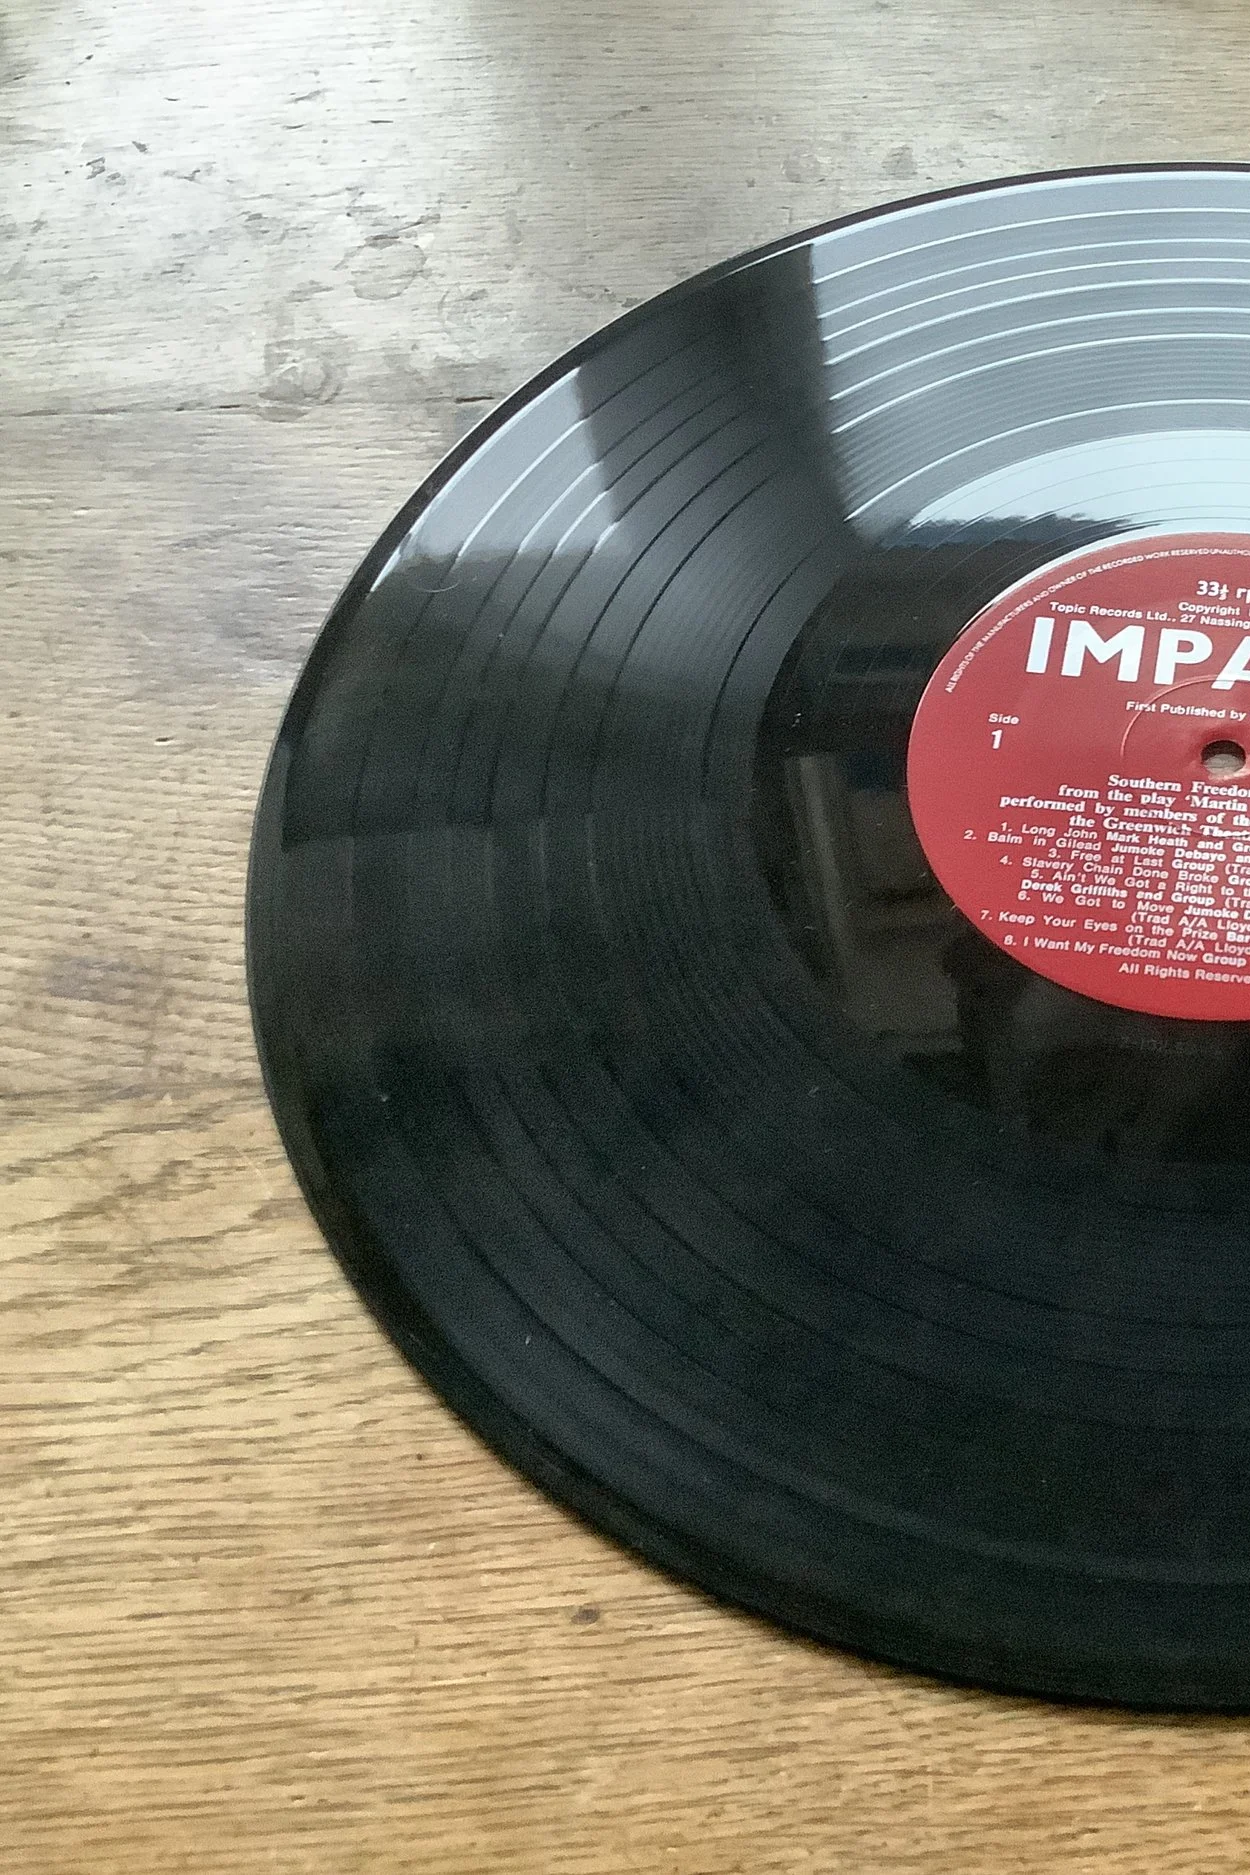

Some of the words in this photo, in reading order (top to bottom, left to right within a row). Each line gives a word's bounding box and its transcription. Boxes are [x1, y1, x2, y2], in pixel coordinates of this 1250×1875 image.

[1049, 601, 1086, 614] Topic
[1089, 605, 1143, 619] Records
[1180, 614, 1196, 623] 27
[1178, 602, 1240, 616] Copyright
[988, 713, 1020, 725] Side
[1125, 701, 1156, 713] First
[1160, 703, 1226, 719] Published
[1230, 709, 1247, 722] by
[990, 729, 1003, 750] 1
[1107, 774, 1182, 792] Southern
[1058, 785, 1099, 799] from
[1107, 789, 1133, 802] the
[1140, 793, 1176, 807] play
[999, 795, 1086, 812] performed
[1095, 802, 1115, 816] by
[1123, 807, 1198, 823] members
[1206, 812, 1225, 825] of
[1000, 822, 1012, 832] 1.
[1021, 823, 1056, 838] Long
[1064, 827, 1098, 840] John
[1106, 831, 1140, 844] Mark
[1147, 834, 1189, 848] Heath
[1197, 839, 1224, 851] and
[1069, 815, 1095, 828] the
[1103, 817, 1192, 836] Greenwich
[963, 830, 977, 840] 2.
[987, 831, 1023, 844] Balm
[1033, 835, 1047, 847] in
[1056, 837, 1102, 851] Gilead
[1111, 842, 1165, 857] Jumoke
[1175, 847, 1227, 863] Debayo
[999, 854, 1013, 866] 4.
[1022, 856, 1074, 873] Slavery
[1083, 862, 1124, 876] Chain
[1133, 866, 1169, 880] Done
[1178, 870, 1219, 884] Broke
[1048, 848, 1061, 859] 3.
[1070, 850, 1102, 862] Free
[1111, 854, 1125, 864] at
[1133, 855, 1164, 868] Last
[1171, 858, 1216, 873] Group
[1021, 879, 1063, 893] Derek
[1070, 883, 1128, 898] Griffiths
[1136, 890, 1163, 901] and
[1171, 891, 1216, 906] Group
[1030, 869, 1044, 880] 5.
[1094, 874, 1117, 886] We
[1124, 877, 1150, 889] Got
[1157, 882, 1167, 891] a
[1175, 881, 1213, 896] Right
[1221, 885, 1235, 896] to
[1017, 890, 1031, 901] 6.
[1042, 892, 1065, 904] We
[1074, 894, 1101, 907] Got
[1112, 899, 1126, 910] to
[1136, 901, 1175, 914] Move
[1183, 903, 1239, 919] Jumoke
[979, 909, 993, 921] 7.
[998, 911, 1035, 925] Keep
[1043, 915, 1076, 928] Your
[1083, 918, 1118, 933] Eyes
[1125, 924, 1143, 934] on
[1151, 924, 1174, 937] the
[1181, 927, 1218, 941] Prize
[1131, 911, 1170, 925] (Trad
[1178, 915, 1208, 929] A/A
[1003, 934, 1017, 946] 8.
[1023, 936, 1029, 947] I
[1034, 936, 1070, 951] Want
[1073, 940, 1096, 955] My
[1099, 943, 1161, 959] Freedom
[1166, 949, 1198, 962] Now
[1202, 953, 1247, 968] Group
[1127, 934, 1167, 948] (Trad
[1175, 938, 1206, 951] A/A
[1118, 962, 1140, 975] All
[1144, 964, 1191, 980] Rights
